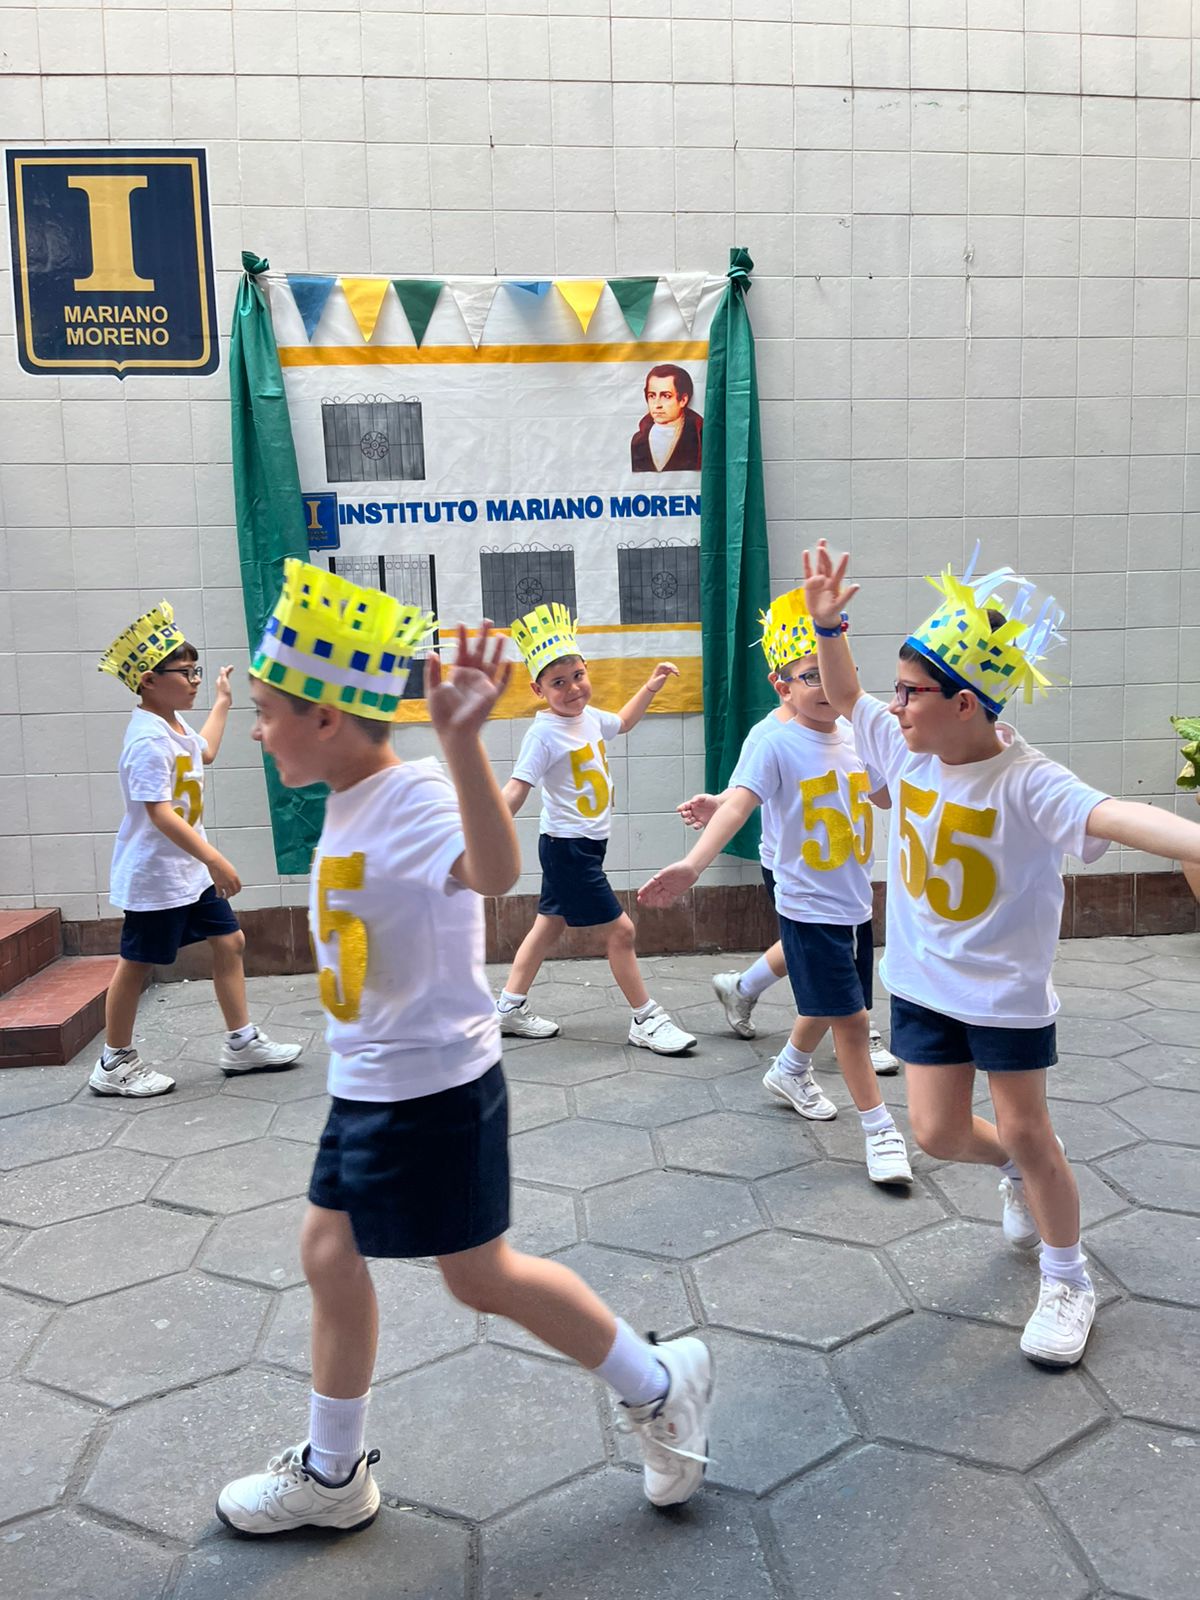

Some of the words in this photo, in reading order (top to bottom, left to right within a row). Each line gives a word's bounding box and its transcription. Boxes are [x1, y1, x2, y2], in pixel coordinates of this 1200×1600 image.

[67, 175, 155, 292] I
[64, 305, 169, 324] MARIANO
[66, 327, 170, 346] MORENO
[306, 500, 322, 529] I
[338, 499, 478, 525] INSTITUTO
[486, 495, 604, 521] MARIANO
[569, 739, 615, 818] 5
[800, 769, 874, 872] 55
[899, 777, 998, 922] 55
[309, 847, 369, 1024] 5
